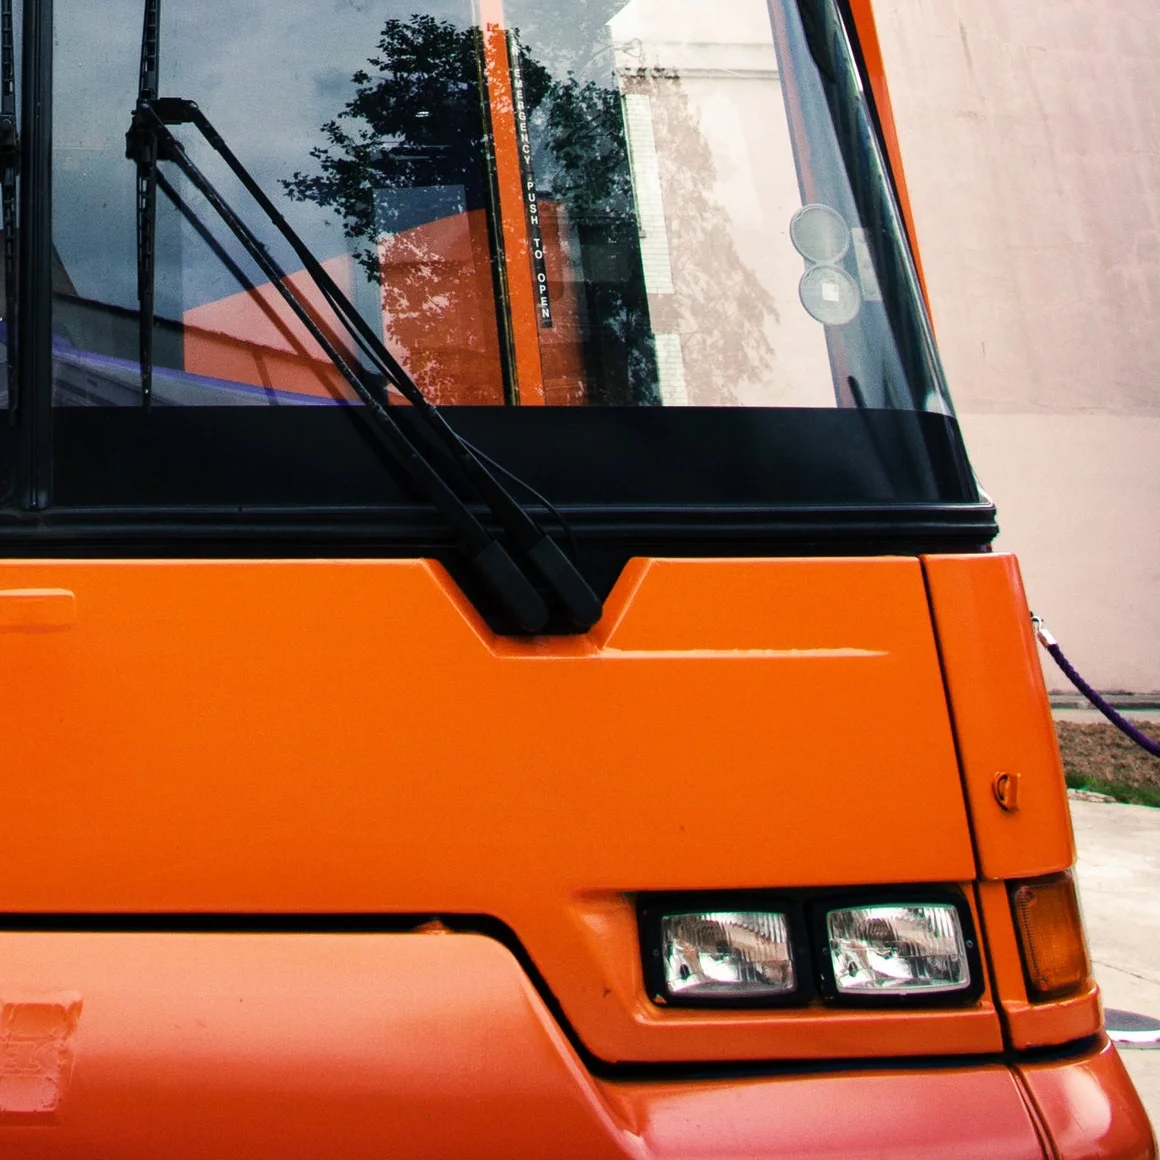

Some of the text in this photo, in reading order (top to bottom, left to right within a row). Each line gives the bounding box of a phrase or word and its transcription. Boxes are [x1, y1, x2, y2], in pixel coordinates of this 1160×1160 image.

[514, 68, 531, 165] EMERGENCY
[527, 181, 539, 225] PUSH
[533, 237, 543, 259] TO
[537, 272, 550, 318] OPEN
